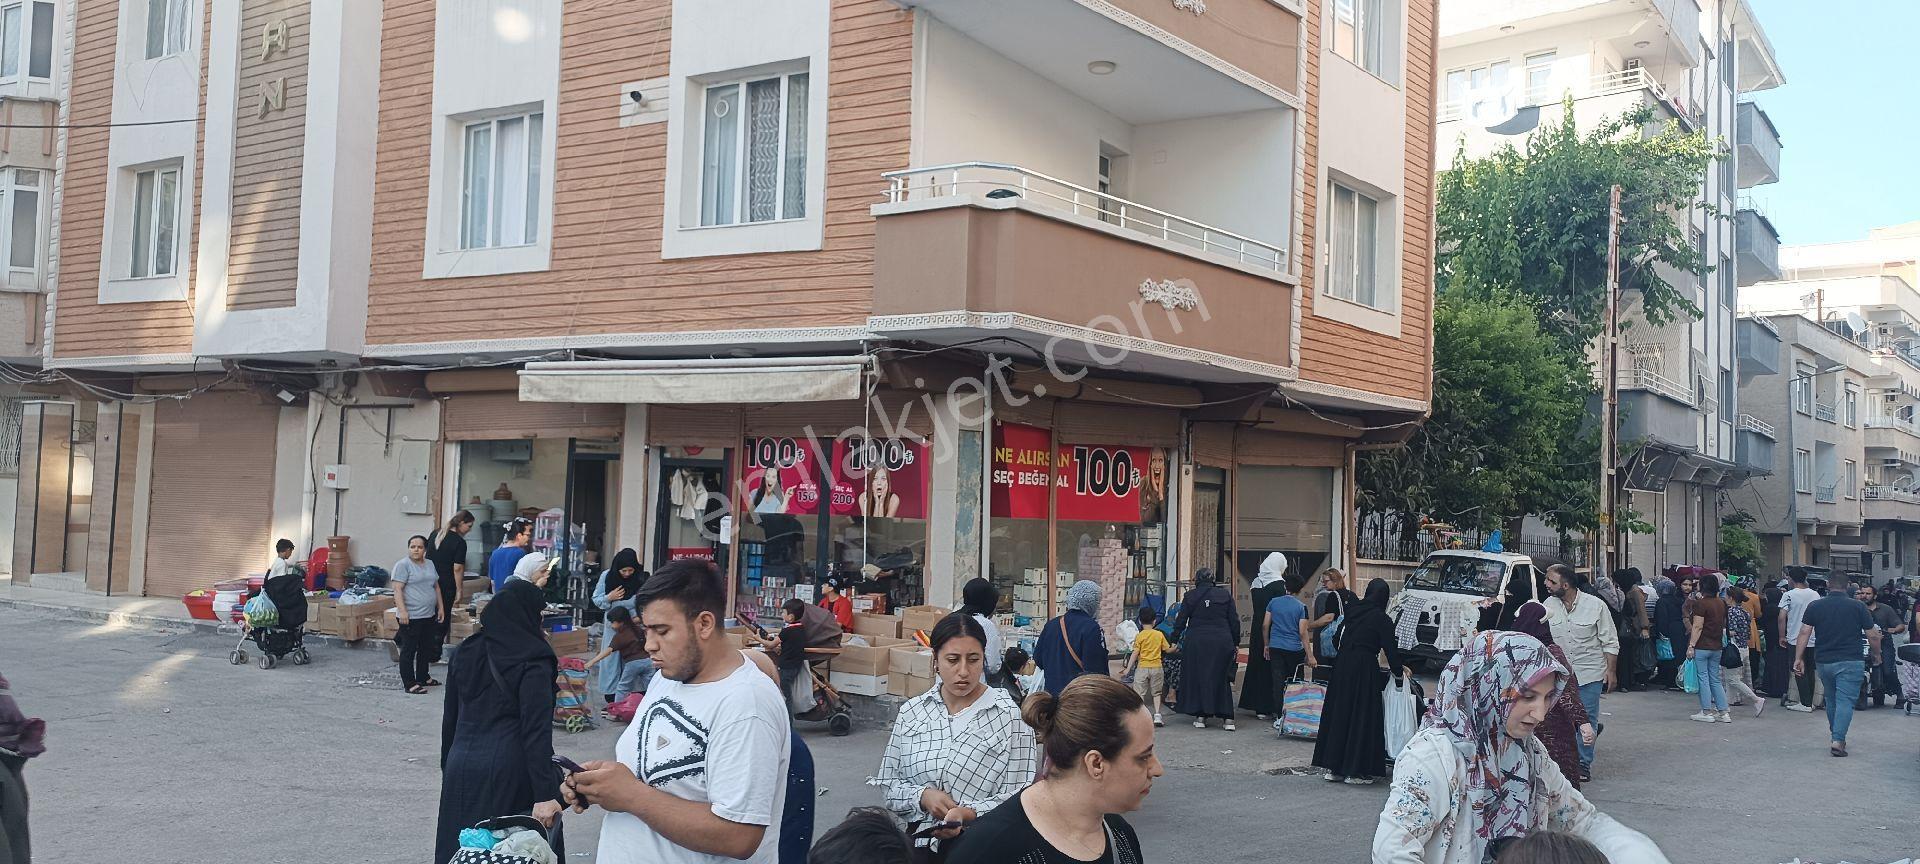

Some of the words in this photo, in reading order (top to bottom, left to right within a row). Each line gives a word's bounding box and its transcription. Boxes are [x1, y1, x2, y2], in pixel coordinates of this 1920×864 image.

[995, 446, 1014, 464] NE
[993, 469, 1015, 488] SEÇ
[1056, 474, 1069, 488] AL
